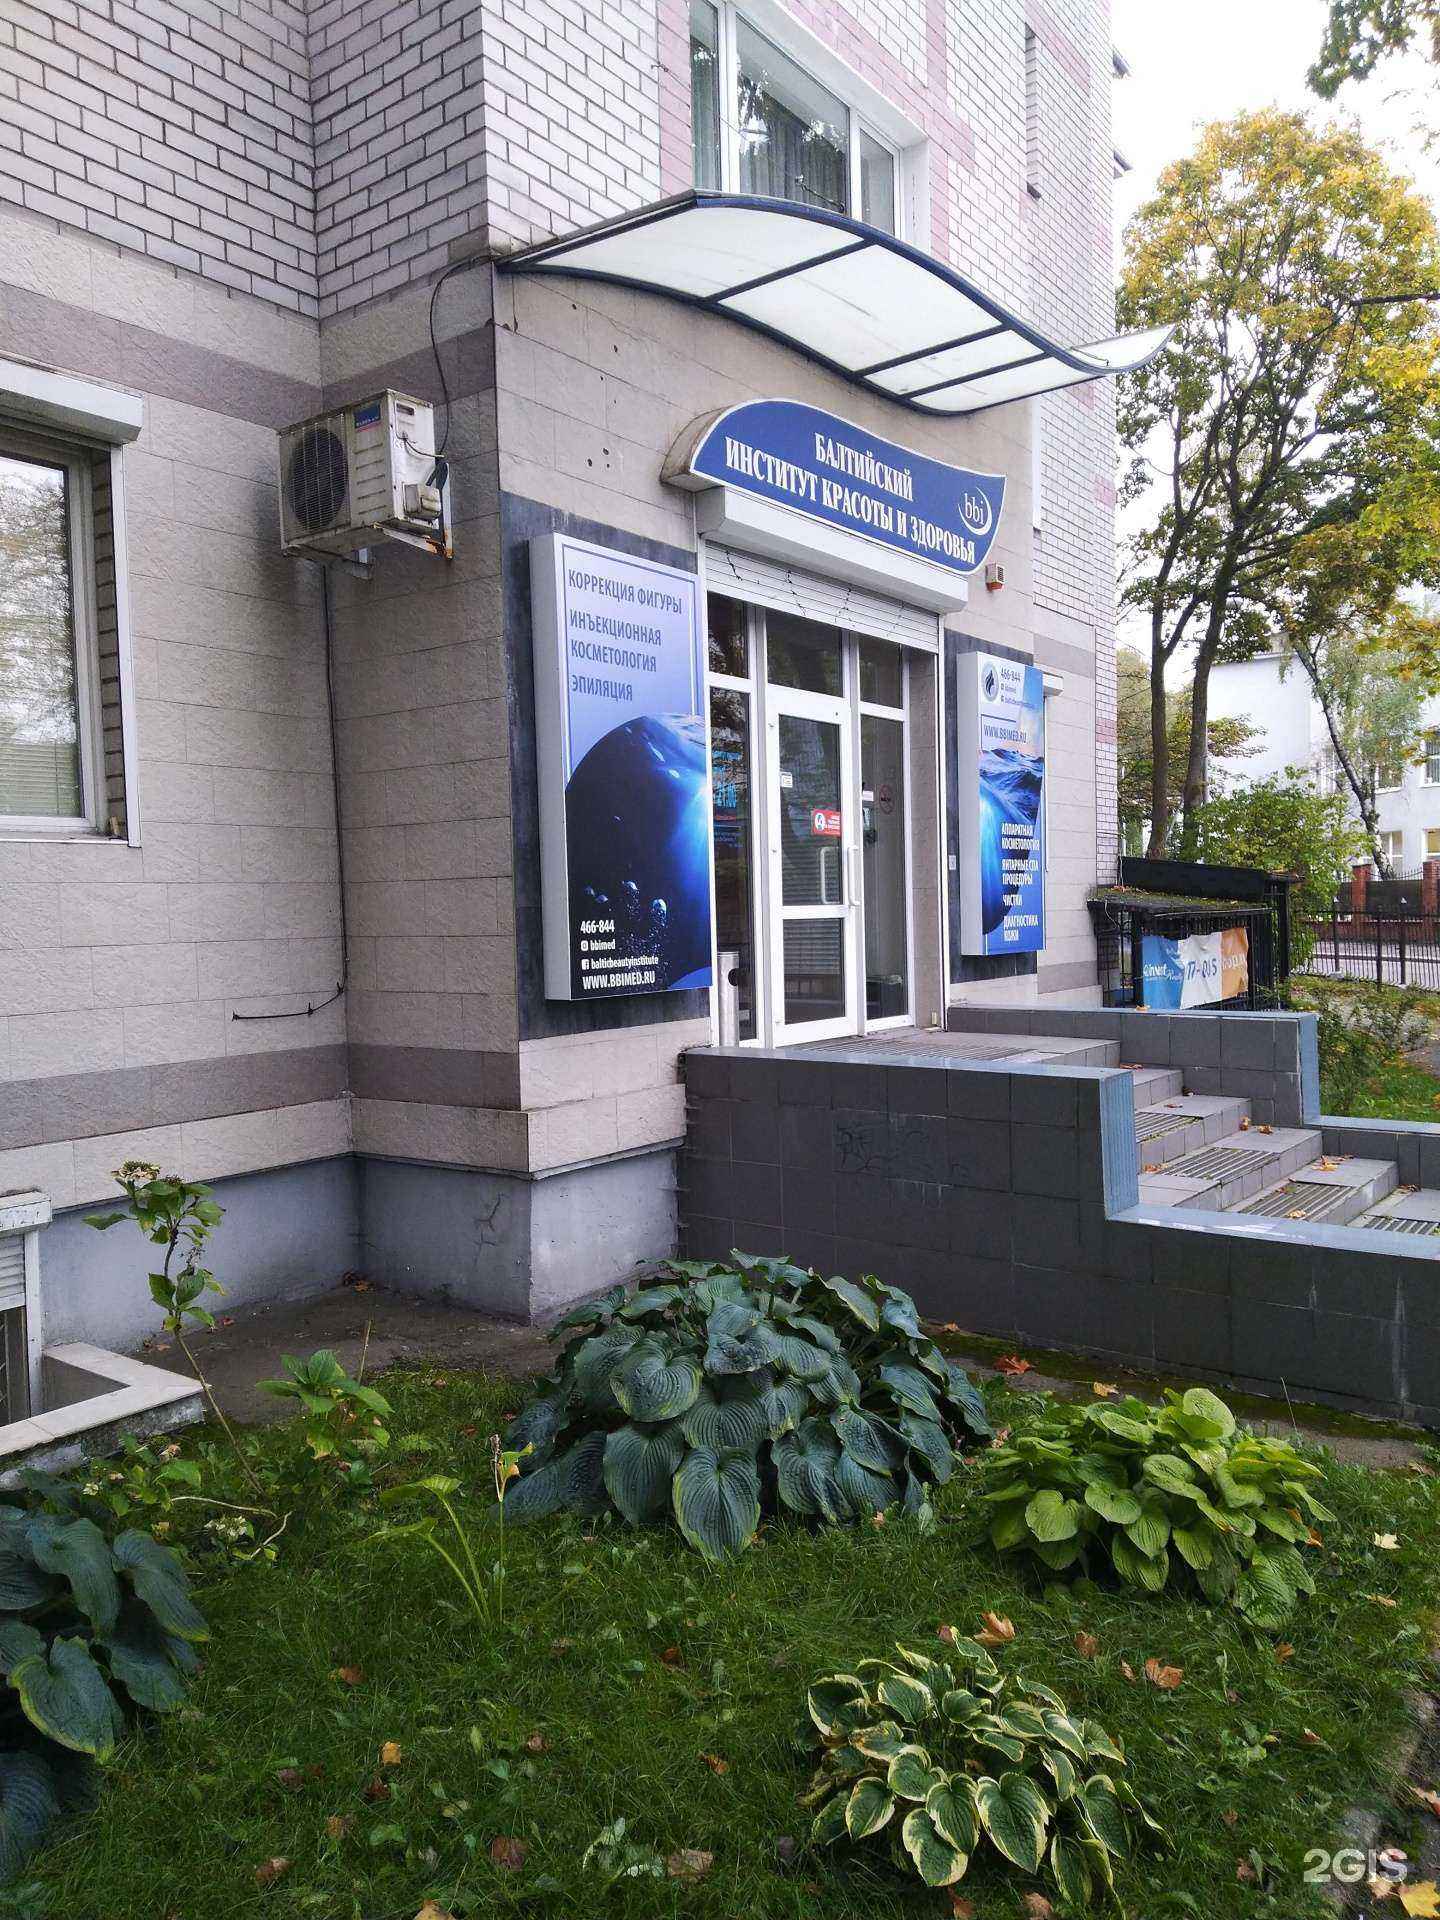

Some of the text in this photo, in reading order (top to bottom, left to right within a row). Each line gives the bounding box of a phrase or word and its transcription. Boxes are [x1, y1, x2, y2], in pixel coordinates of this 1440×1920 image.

[814, 432, 913, 501] БАЛТИЙСКИЙ
[725, 436, 975, 564] ИНСТИТУТ КРАСОТЫ И ЗДОРОВЬЯ
[964, 493, 984, 525] bbi
[568, 569, 682, 615] КОРРЕКЦИЯ ФИГУРЫ
[570, 609, 662, 646] ИНЪЕКЦИОННАЯ
[571, 639, 656, 672] КОСМЕТОЛОГИЯ
[572, 674, 633, 702] ЭПИЛЯЦИЯ
[580, 920, 615, 933] 466-844
[590, 939, 616, 951] bbimed
[591, 955, 659, 971] balticbeautyinstitute
[582, 971, 656, 990] WWW.BBIMED.RU
